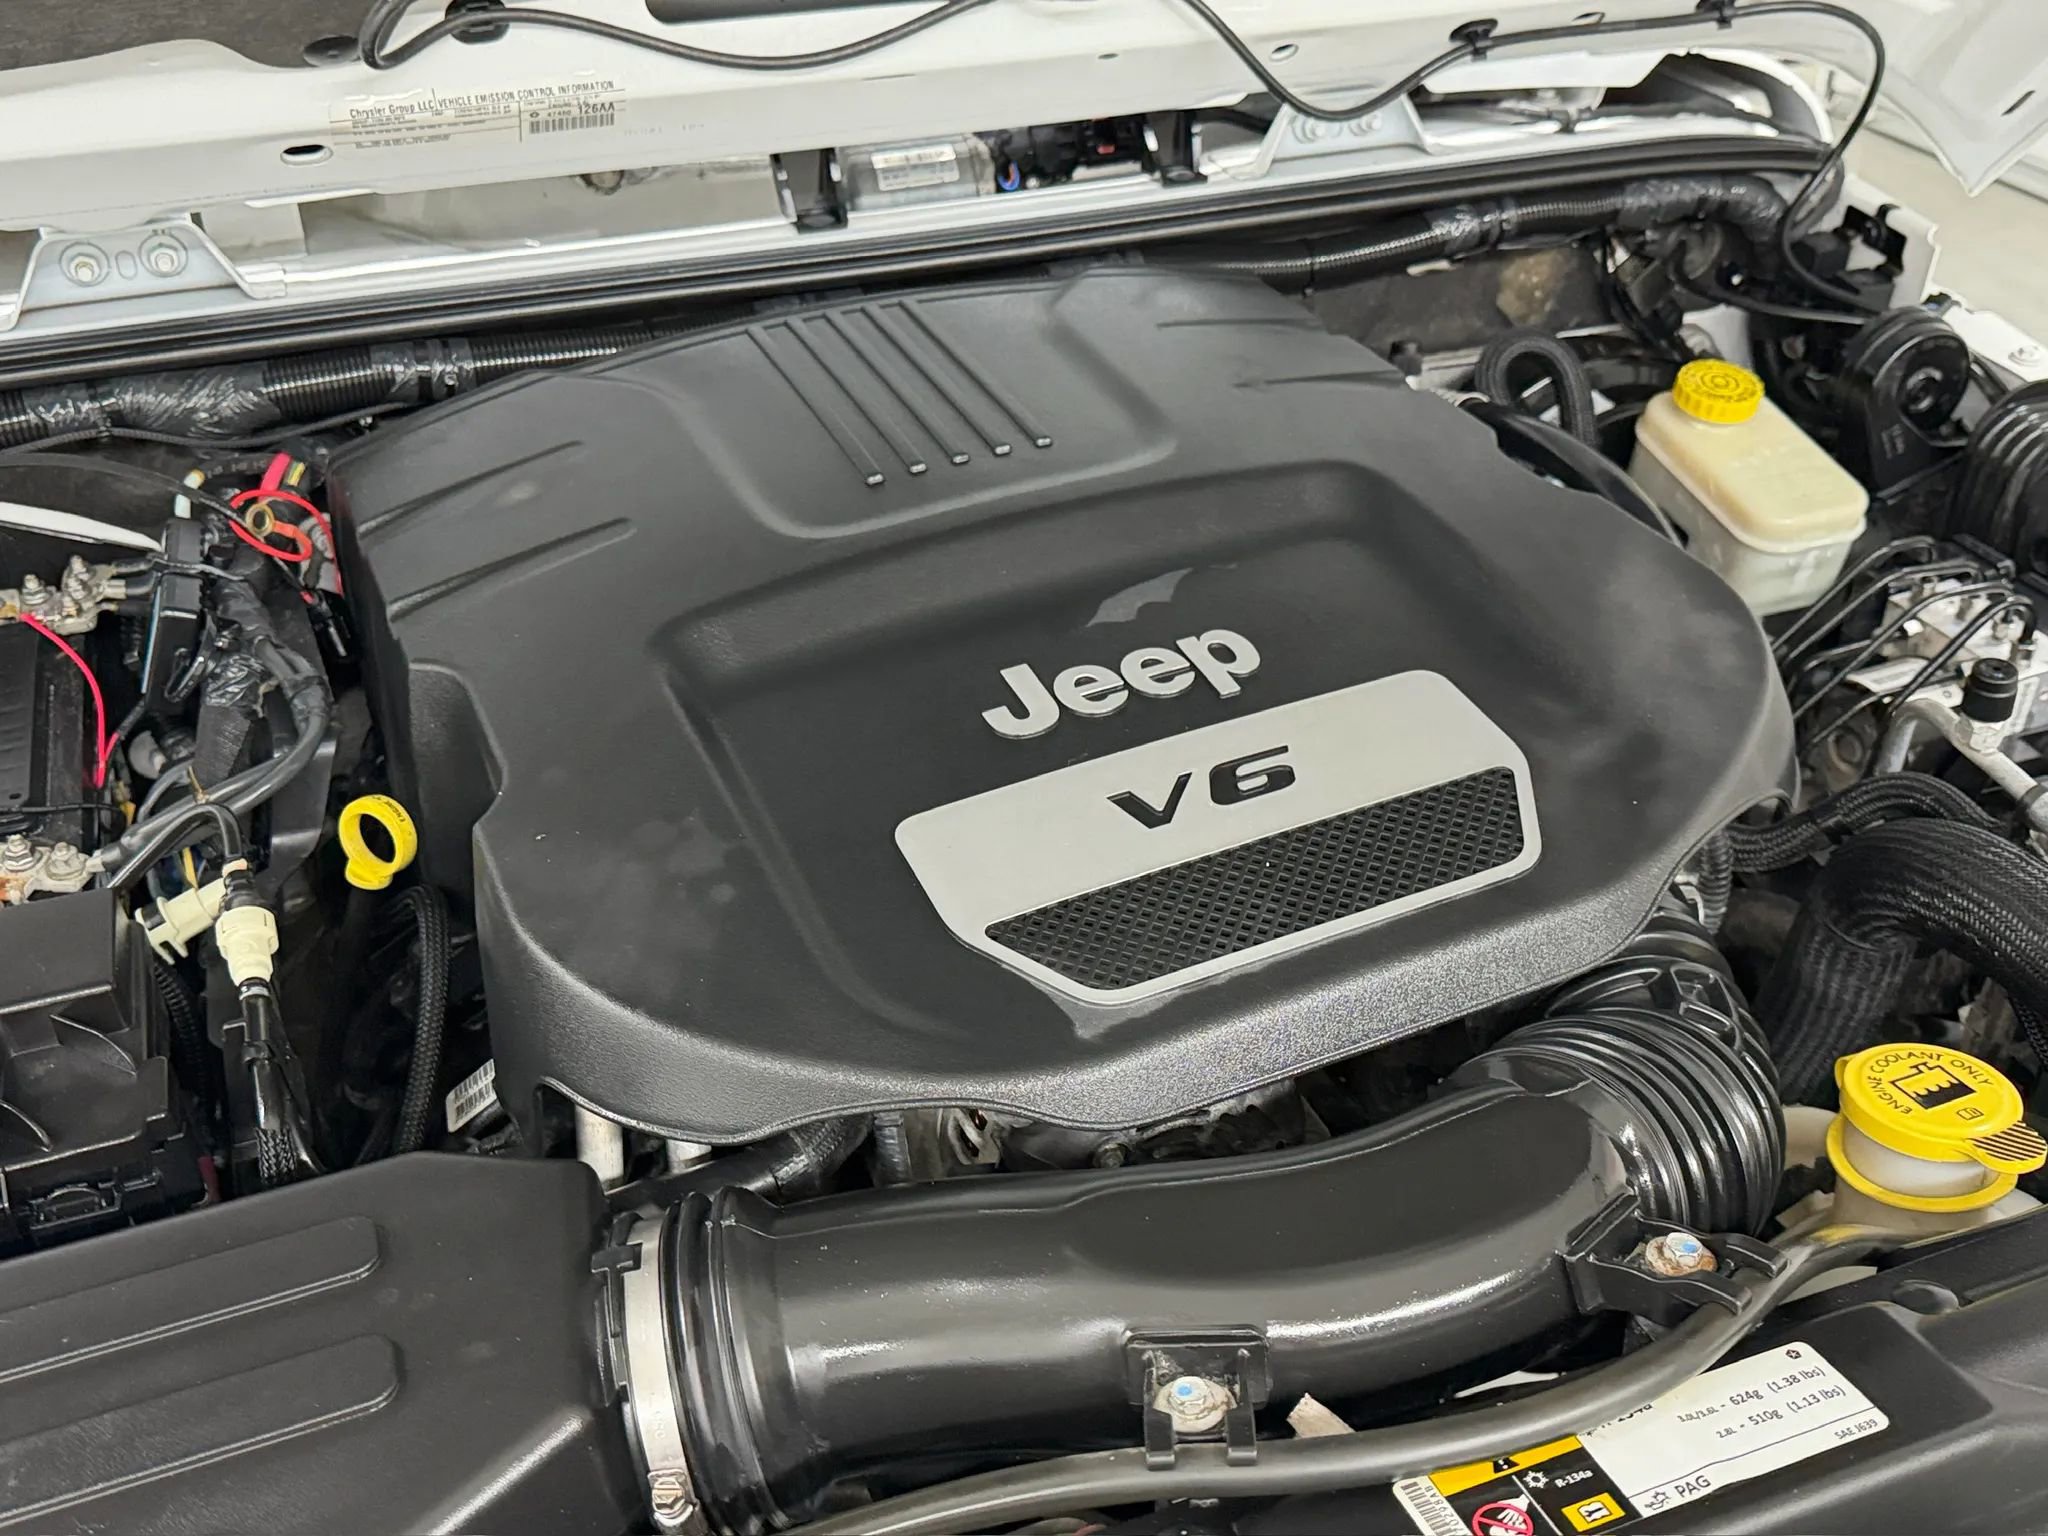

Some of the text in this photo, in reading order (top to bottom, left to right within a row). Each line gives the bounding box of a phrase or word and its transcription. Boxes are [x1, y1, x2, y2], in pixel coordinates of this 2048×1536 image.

[350, 106, 386, 119] Chrysler
[389, 104, 415, 114] Group
[417, 100, 435, 111] LLC
[438, 96, 472, 108] VEHICLE
[475, 91, 515, 104] EMISSION
[517, 87, 556, 100] CONTROL
[558, 80, 615, 94] INFORMATION
[981, 628, 1261, 740] Jeep
[1106, 745, 1296, 829] V6
[1867, 1051, 1994, 1115] ENGINE COOLANT ONLY
[1728, 1388, 1764, 1406] 624g
[1766, 1374, 1801, 1394] (1.38
[1799, 1365, 1826, 1381] lbs)
[1747, 1407, 1784, 1426] 510g
[1786, 1394, 1821, 1414] (1.13
[1819, 1384, 1847, 1401] lbs)
[1833, 1417, 1879, 1441] SAE J639
[1554, 1468, 1593, 1488] R-134a
[1673, 1474, 1712, 1498] PAG
